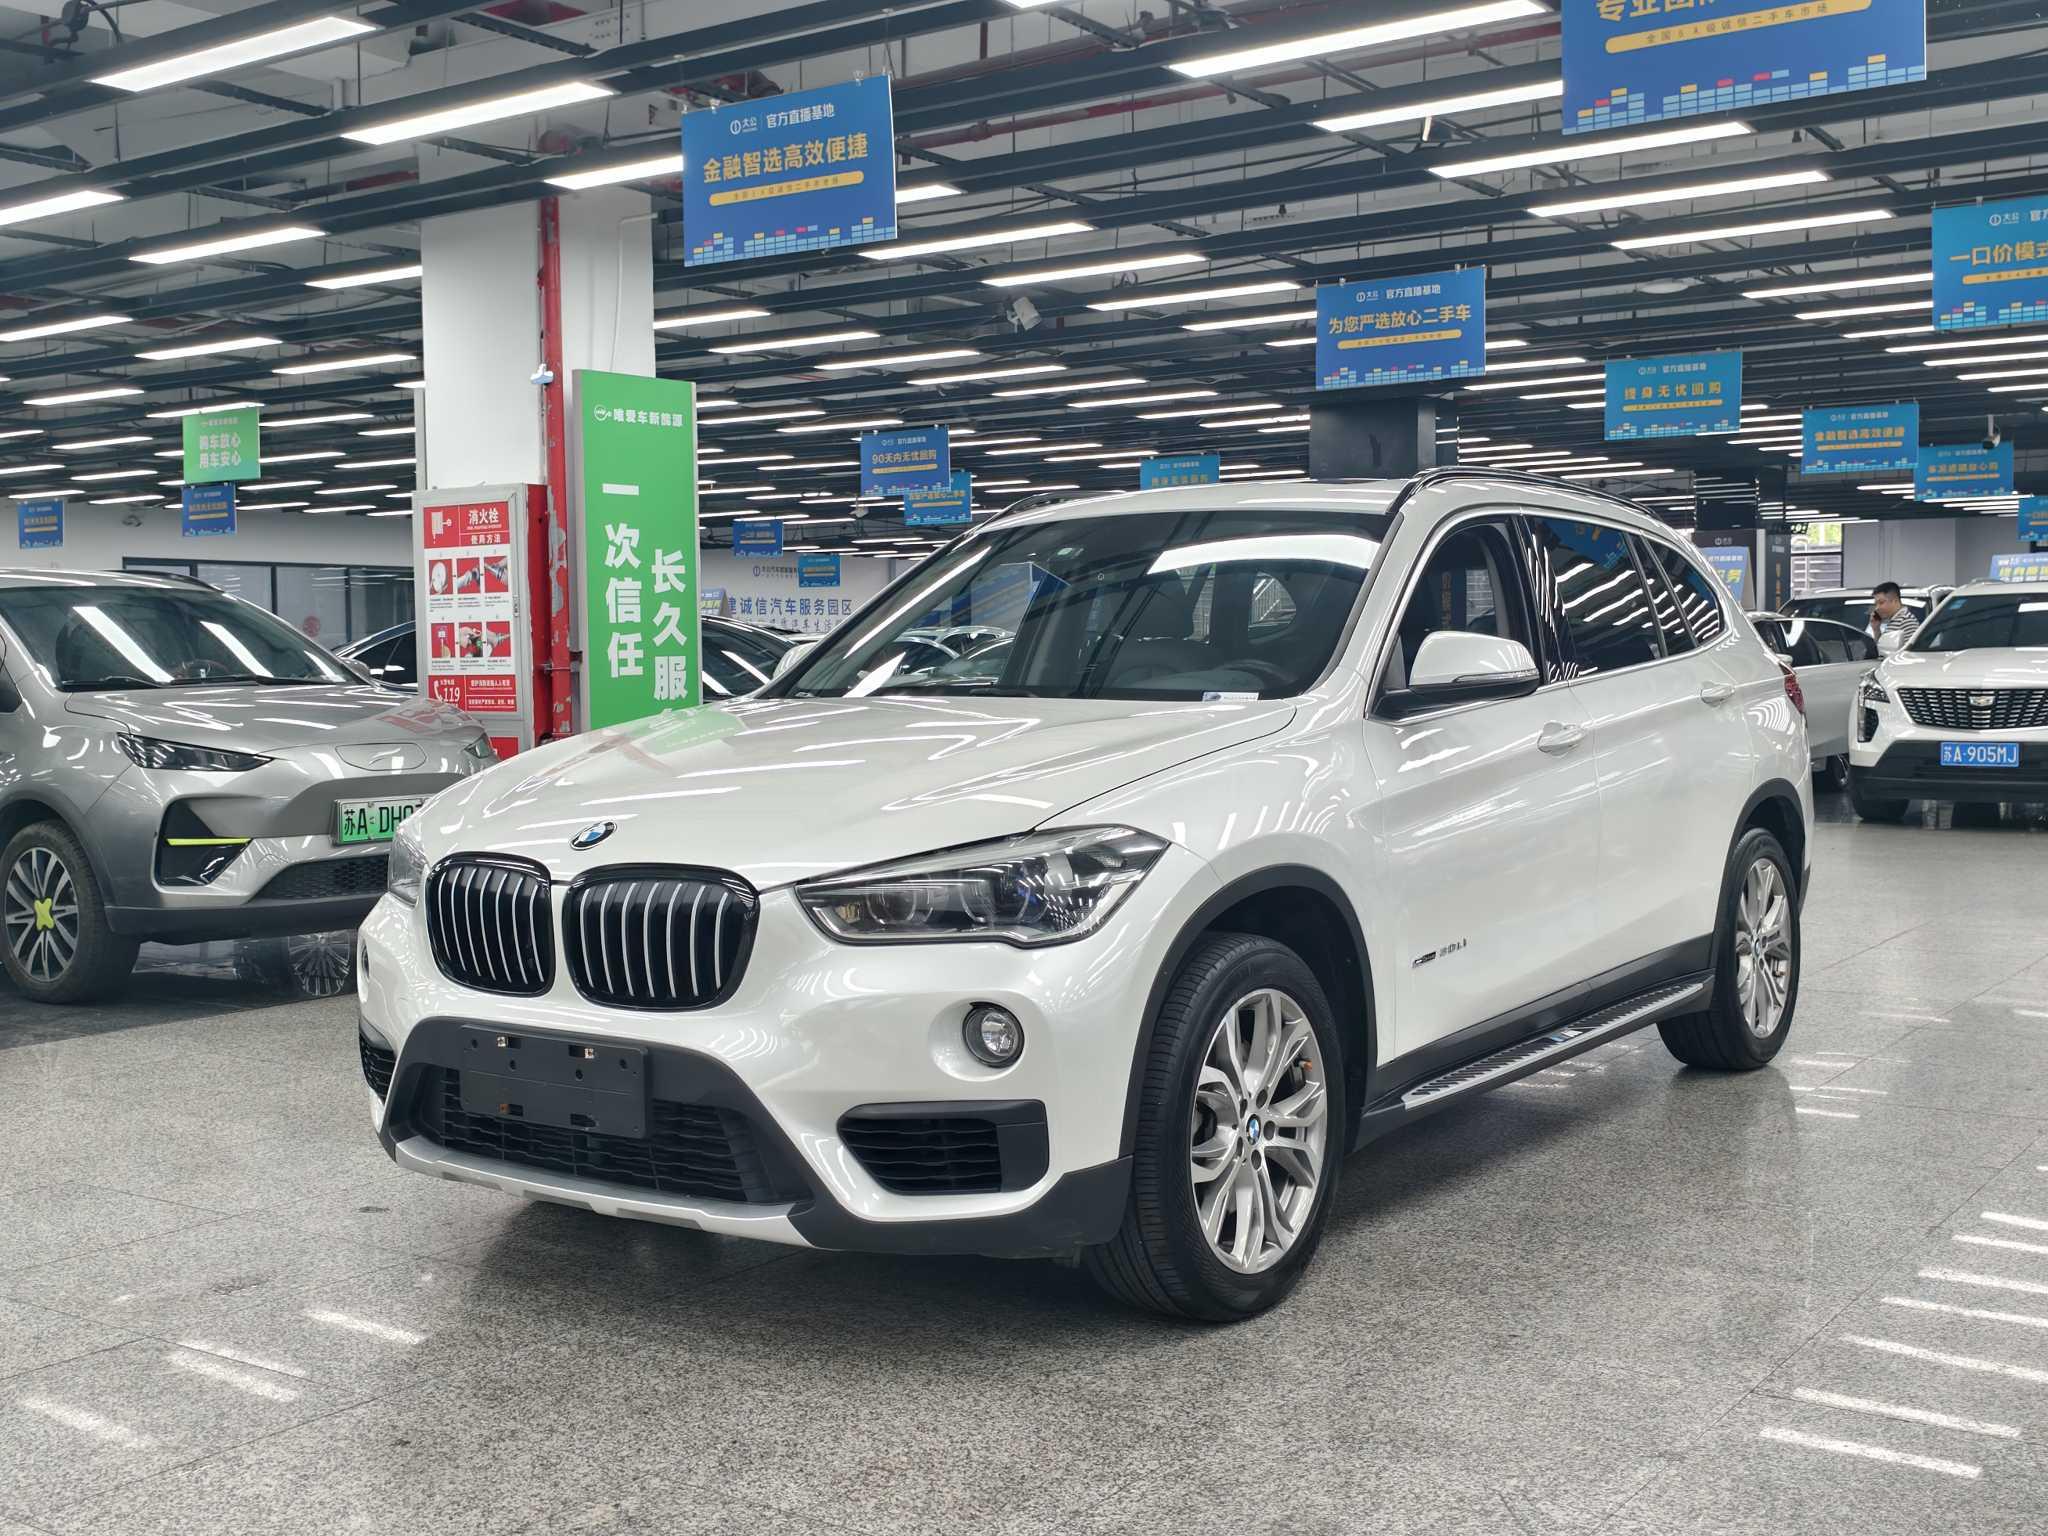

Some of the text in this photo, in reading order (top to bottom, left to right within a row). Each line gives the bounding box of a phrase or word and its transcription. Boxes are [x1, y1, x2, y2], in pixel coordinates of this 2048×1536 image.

[766, 103, 835, 128] 官方直播基地
[703, 132, 869, 183] 金融智选高效便捷
[1328, 303, 1472, 334] 为您严选放心二手车
[469, 507, 499, 525] 消火栓
[471, 533, 501, 545] 使用方法
[601, 483, 644, 678] 一次信任
[443, 687, 460, 702] 119
